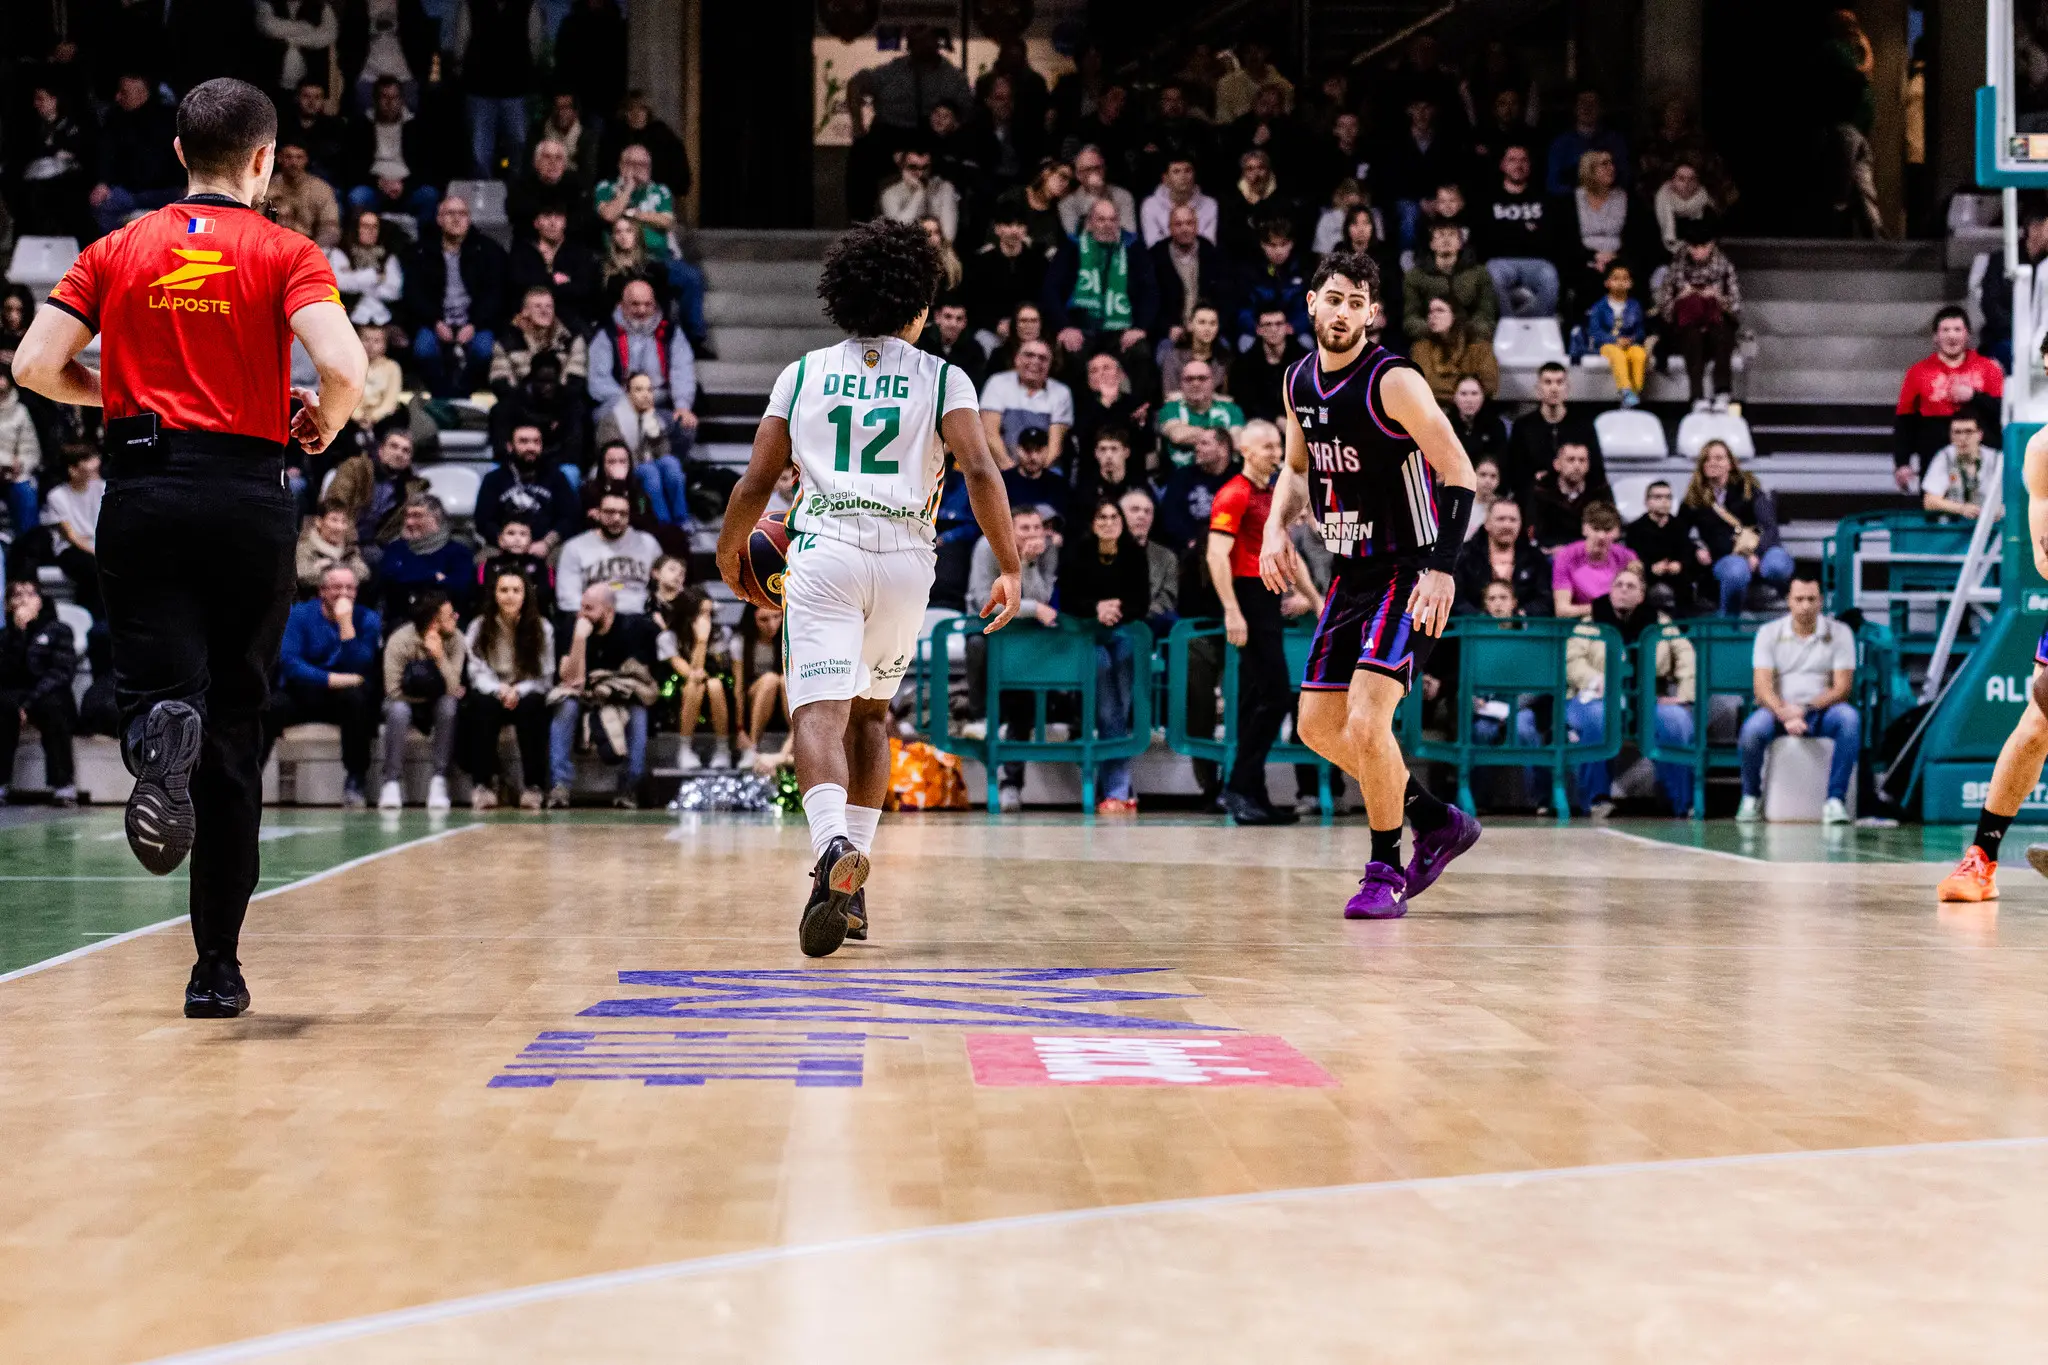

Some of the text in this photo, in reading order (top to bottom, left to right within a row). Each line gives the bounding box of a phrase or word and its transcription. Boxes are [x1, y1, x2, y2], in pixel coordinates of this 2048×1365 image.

[149, 295, 230, 314] LA POSTE
[823, 373, 909, 400] DELAG
[827, 405, 901, 474] 12
[829, 490, 857, 501] agglo
[1320, 477, 1333, 507] 7
[797, 533, 818, 553] 12
[799, 659, 828, 672] Thierry
